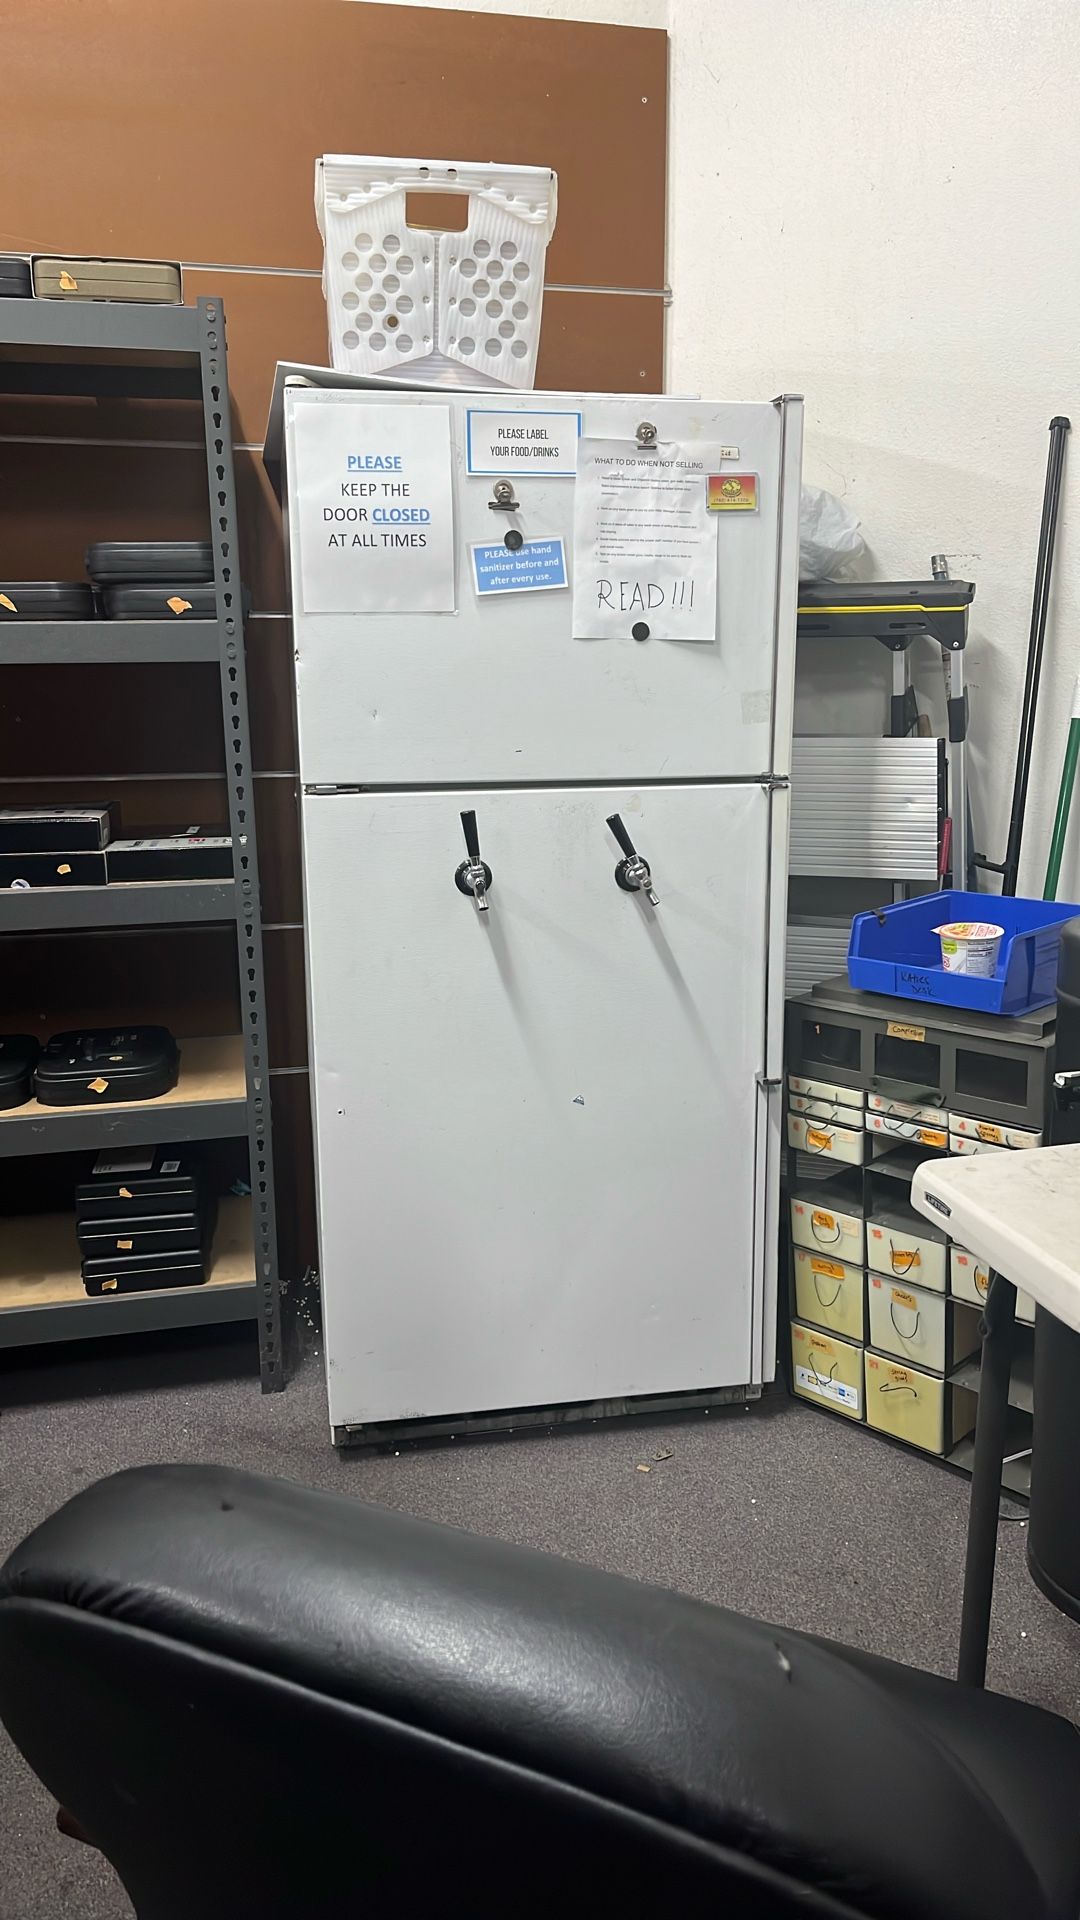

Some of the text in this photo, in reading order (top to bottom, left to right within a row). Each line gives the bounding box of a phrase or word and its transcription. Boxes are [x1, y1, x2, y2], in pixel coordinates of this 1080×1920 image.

[498, 428, 549, 440] PLEASE LABEL
[490, 446, 559, 457] YOUR FOOD/DRINKS
[347, 455, 403, 472] PLEASE
[595, 457, 613, 465] WHAT
[616, 458, 625, 466] TO
[638, 460, 658, 468] WHEN
[676, 461, 704, 469] SELLING
[341, 483, 410, 497] KEEP THE
[323, 507, 431, 525] DOOR CLOSED
[328, 533, 427, 547] AT ALL TIMES
[531, 545, 552, 555] hand
[480, 557, 560, 573] sanitizer before and
[490, 572, 553, 586] after every use.
[815, 1024, 821, 1034] 1
[959, 1121, 966, 1131] 4
[957, 1139, 964, 1149] 7
